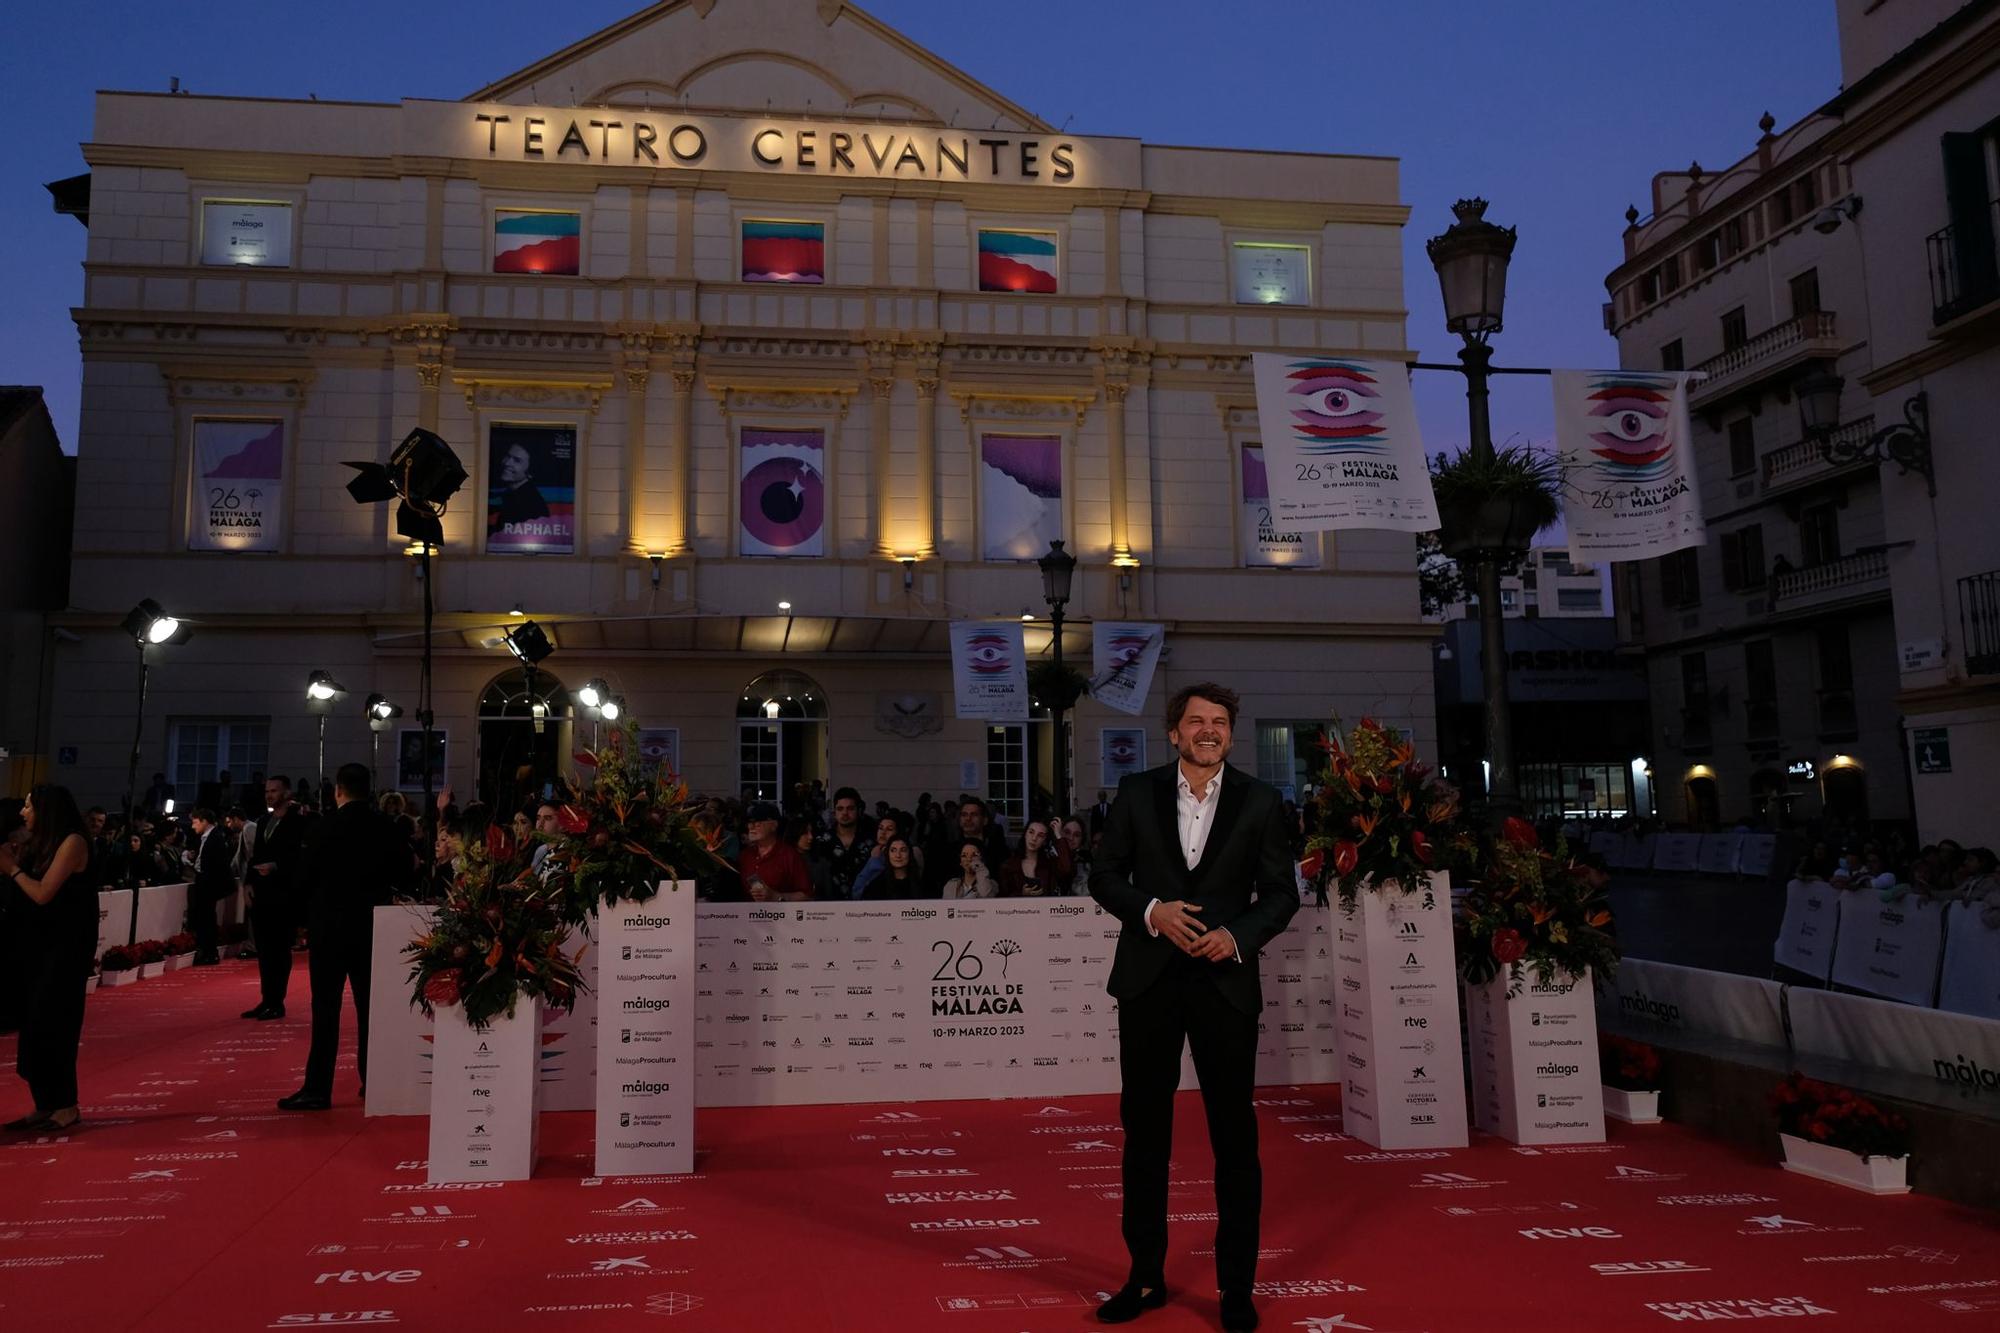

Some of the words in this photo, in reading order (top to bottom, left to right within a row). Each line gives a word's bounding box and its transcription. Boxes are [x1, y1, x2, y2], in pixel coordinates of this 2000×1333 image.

[476, 113, 708, 160] TEATRO
[751, 129, 1076, 178] CERVANTES
[1341, 461, 1383, 470] FESTIVAL
[1295, 463, 1321, 481] 26
[1629, 482, 1674, 498] FESTIVAL
[1674, 475, 1686, 484] DE
[211, 487, 240, 509] 26
[1591, 489, 1614, 509] 26
[210, 510, 248, 518] FESTIVAL
[1628, 509, 1653, 518] MARZO
[503, 521, 570, 537] RAPHAEL
[749, 909, 785, 919] málaga
[901, 907, 937, 918] málaga
[1049, 904, 1085, 915] málaga
[624, 914, 671, 929] málaga
[733, 937, 748, 945] rtve
[791, 937, 804, 945] rtve
[932, 940, 983, 981] 26
[932, 985, 999, 997] FESTIVAL
[1006, 984, 1024, 995] DE
[1531, 983, 1573, 995] málaga
[623, 996, 670, 1011] málaga
[932, 996, 1023, 1016] MÁLAGA
[1619, 990, 1680, 1022] málaga
[1404, 1015, 1427, 1029] rtve
[933, 1028, 956, 1038] 10-19
[959, 1027, 998, 1037] MARZO
[1000, 1026, 1025, 1036] 2023
[1536, 1062, 1579, 1076] málaga
[1934, 1054, 2000, 1089] mála
[472, 1088, 490, 1097] rtve
[622, 1080, 669, 1094] málaga
[880, 1148, 957, 1157] rtve
[1343, 1151, 1452, 1162] málaga
[892, 1168, 971, 1176] SUR
[384, 1181, 504, 1192] málaga
[884, 1189, 977, 1198] FESTIVAL
[910, 1218, 1041, 1229] málaga
[1518, 1225, 1624, 1239] rtve
[565, 1233, 699, 1244] VICTORIA
[1589, 1260, 1700, 1272] SUR
[314, 1269, 422, 1284] rtve
[546, 1272, 624, 1280] Fundación
[1252, 1283, 1367, 1296] CTORIA
[524, 1303, 634, 1312] ATRESMEDIA
[1644, 1299, 1771, 1311] FESTIVAL
[1773, 1296, 1813, 1305] DE
[277, 1310, 395, 1324] SUR
